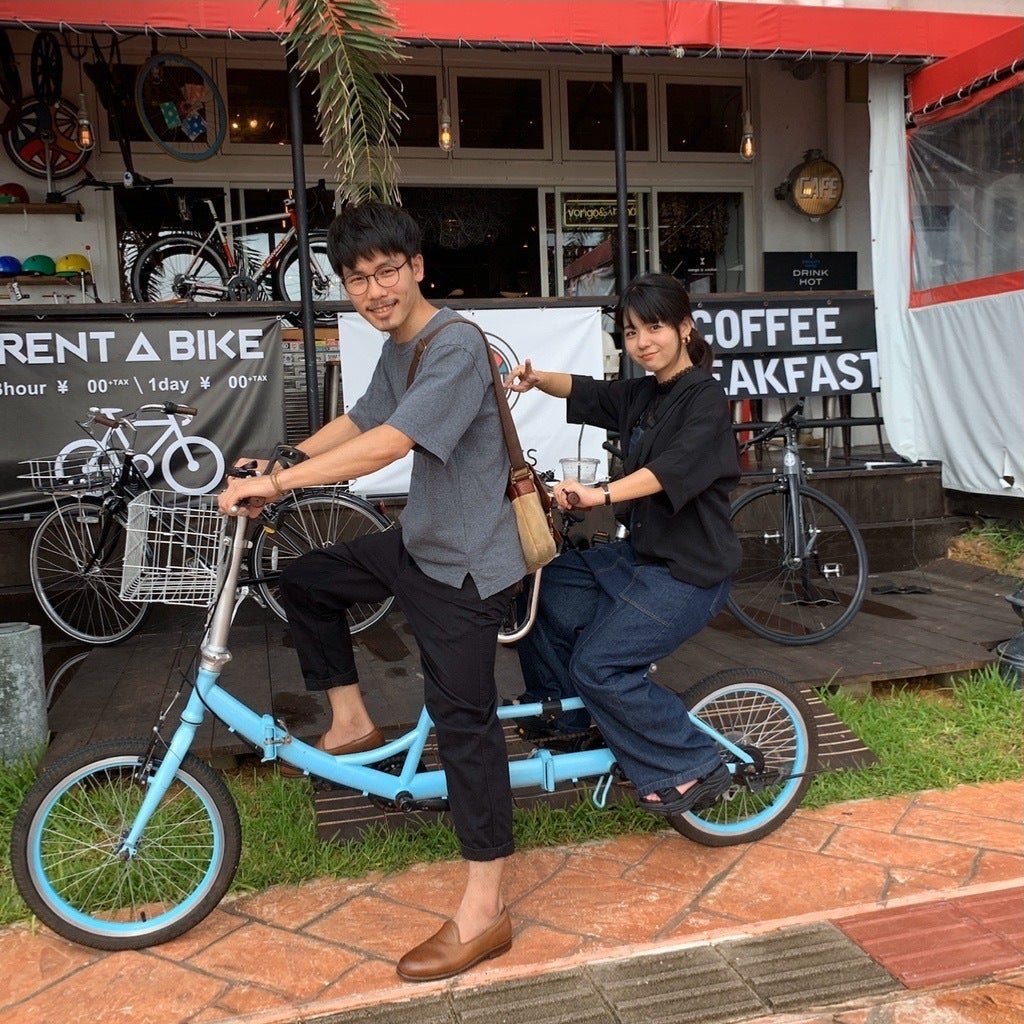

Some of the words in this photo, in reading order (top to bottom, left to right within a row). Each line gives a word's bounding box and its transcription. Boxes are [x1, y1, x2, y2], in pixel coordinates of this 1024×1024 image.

[800, 176, 839, 200] CAFE
[793, 269, 829, 277] DRINK
[799, 278, 822, 286] HOT
[691, 307, 843, 349] COFFEE
[0, 331, 116, 365] RENT
[169, 329, 265, 361] BIKE
[57, 379, 69, 394] ¥
[148, 376, 189, 395] 1day
[200, 376, 211, 389] ¥
[712, 352, 882, 395] AKFAST
